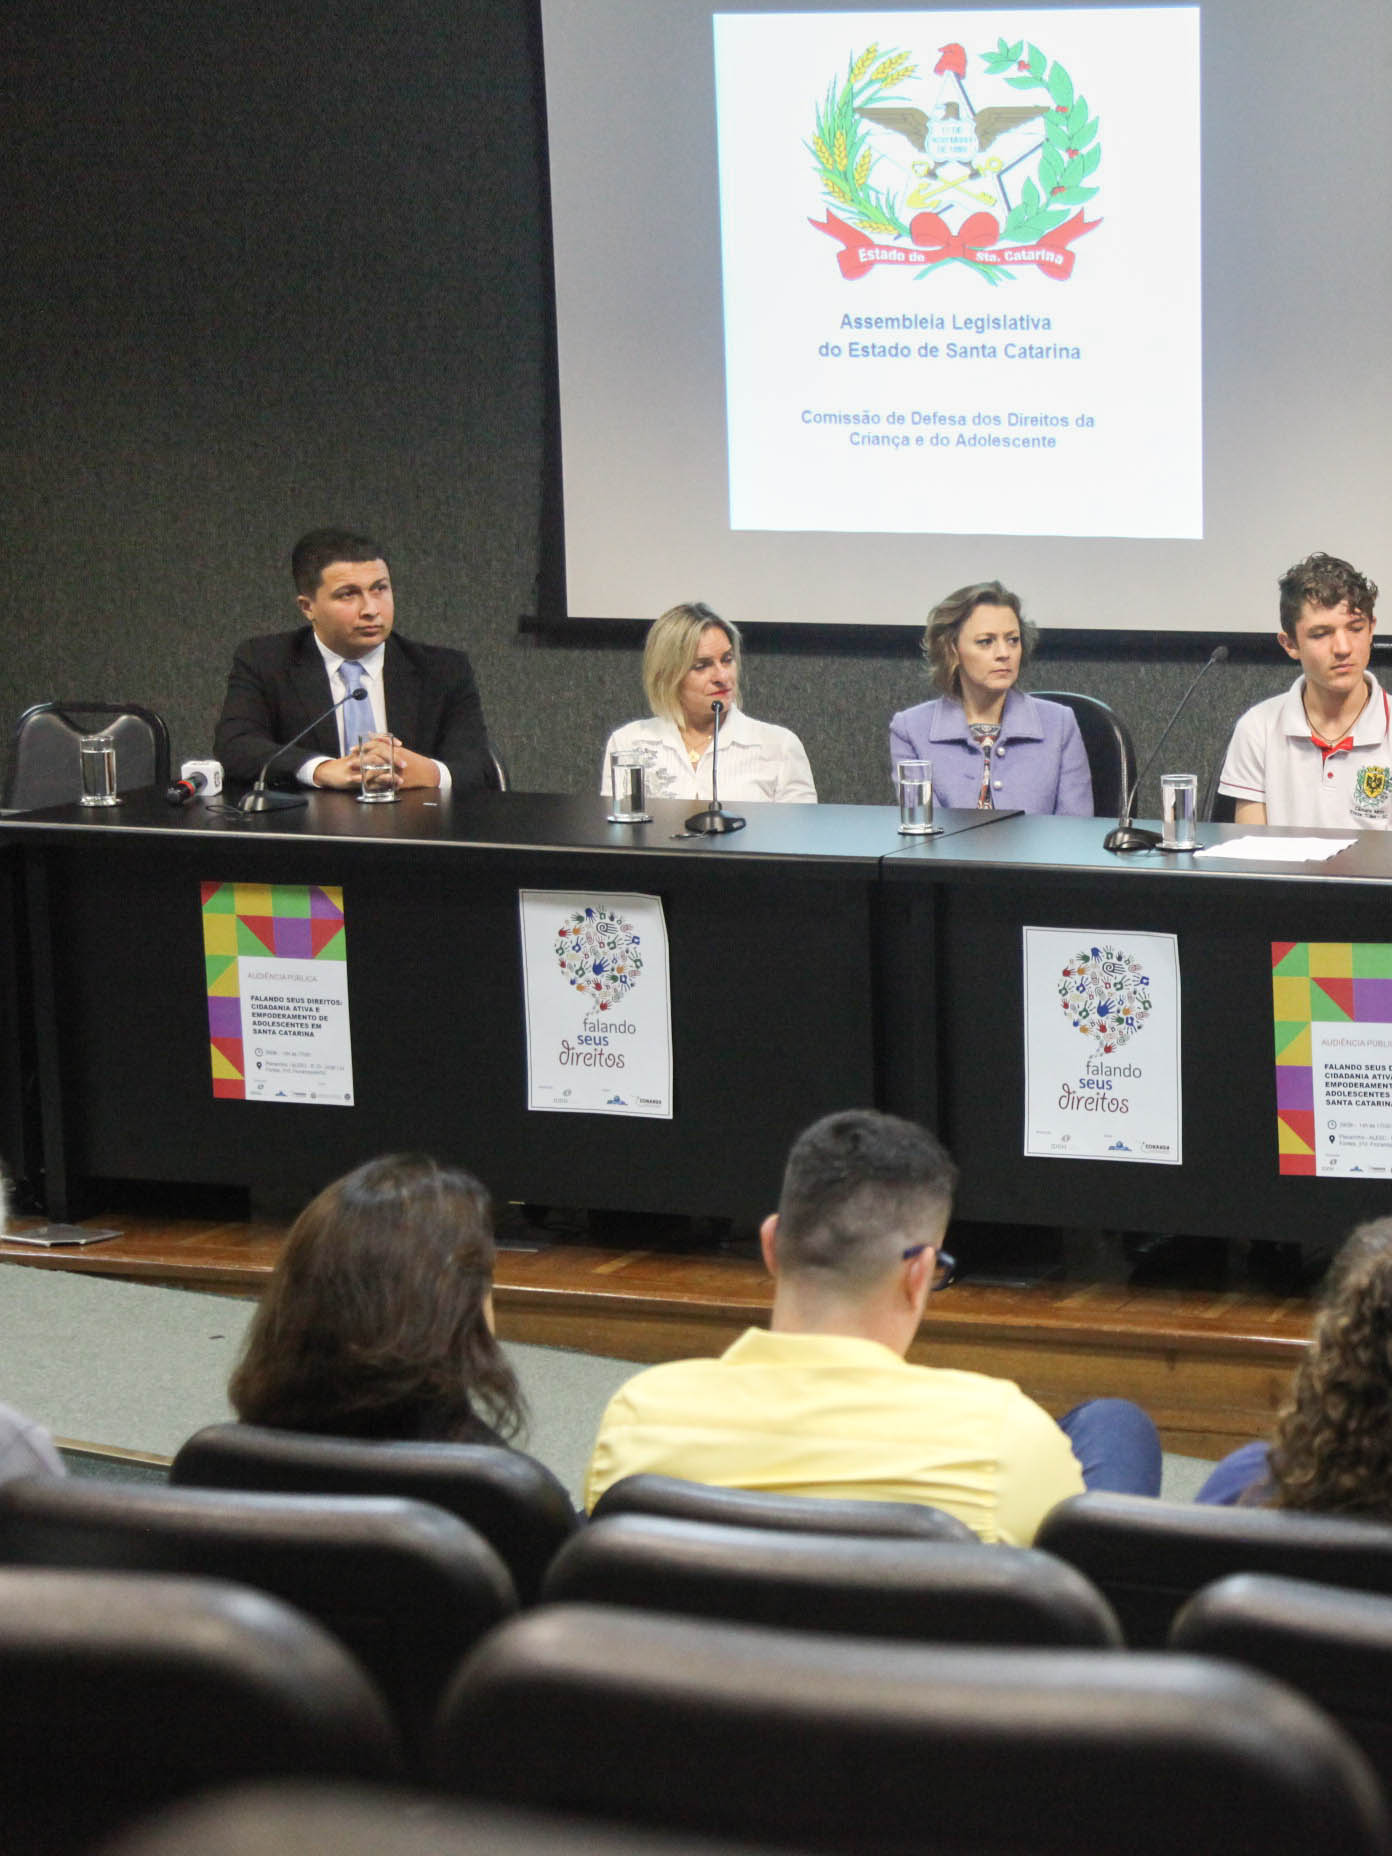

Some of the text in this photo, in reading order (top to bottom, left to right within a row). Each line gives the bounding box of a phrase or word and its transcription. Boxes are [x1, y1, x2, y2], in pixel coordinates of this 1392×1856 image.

[858, 247, 905, 262] Estado
[840, 313, 1051, 334] Assembleia Legislativa
[818, 342, 1081, 359] do Estado de Santa Catarina
[801, 410, 1094, 428] Comissão de Defesa dos Direitos da
[849, 432, 1056, 449] Criança e do Adolescente
[252, 1012, 316, 1021] EMPODERAMENTO
[252, 1021, 309, 1029] ADOLESCENTES
[583, 1018, 636, 1034] falando
[577, 1034, 609, 1046] seus
[559, 1040, 625, 1069] direitos
[1086, 1061, 1142, 1079] falando
[1079, 1077, 1113, 1090] seus
[1058, 1083, 1129, 1114] direitos
